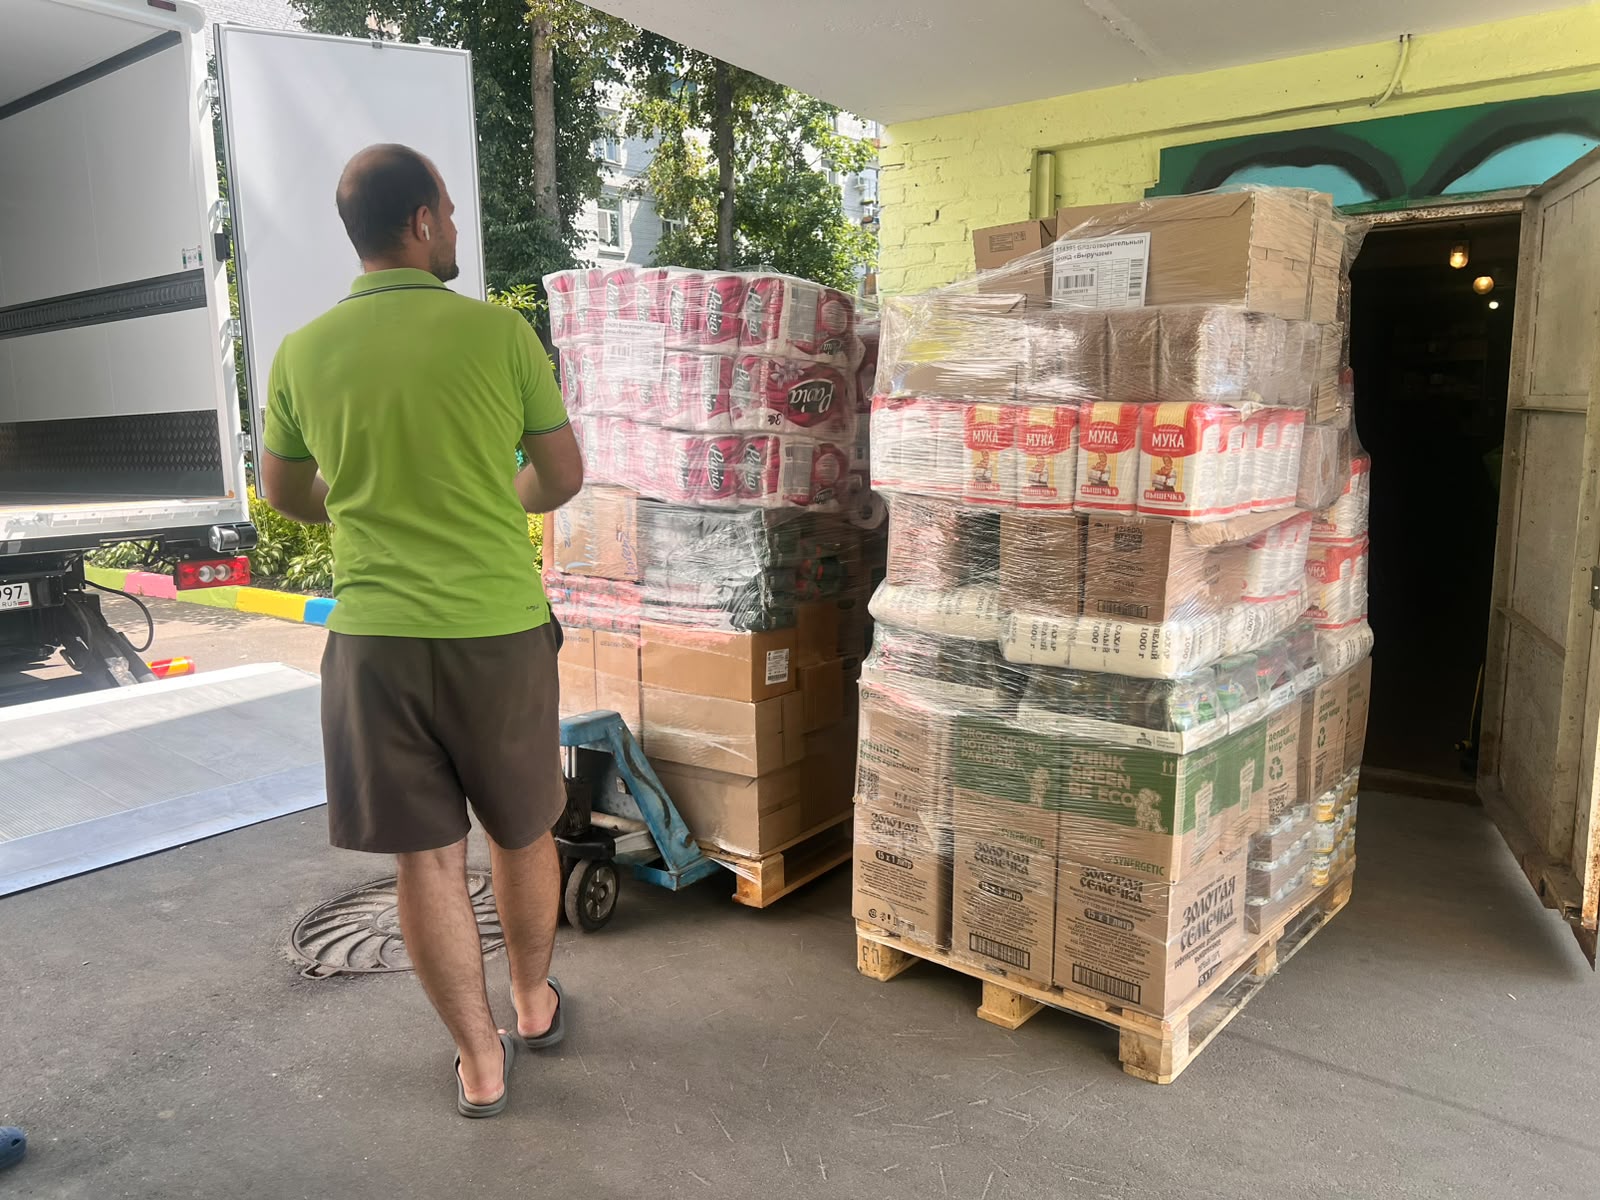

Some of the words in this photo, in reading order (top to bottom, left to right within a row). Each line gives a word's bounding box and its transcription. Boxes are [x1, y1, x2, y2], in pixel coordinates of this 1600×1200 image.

[709, 286, 723, 335] Papia
[972, 430, 999, 443] МУКА
[1026, 433, 1054, 446] МУКА
[1088, 430, 1119, 444] МУКА
[1152, 433, 1185, 448] МУКА
[710, 444, 724, 491] Papia
[1050, 623, 1059, 652] САХАР
[1113, 624, 1122, 654] САХАР
[1139, 627, 1148, 650] 1000
[1150, 627, 1160, 660] БЕЛЫЙ
[1164, 630, 1172, 659] САХАР
[1071, 748, 1126, 771] THINK
[1069, 766, 1131, 790] GREEN
[1098, 788, 1135, 808] ECO
[1113, 855, 1164, 876] SYNERGETIC
[1080, 866, 1143, 892] ЗОЛОТАЯ
[1080, 877, 1142, 903] СЕМЕЧКА
[1181, 875, 1236, 932] ЗОЛОТАЯ
[1181, 898, 1233, 953] СЕМЕЧКА
